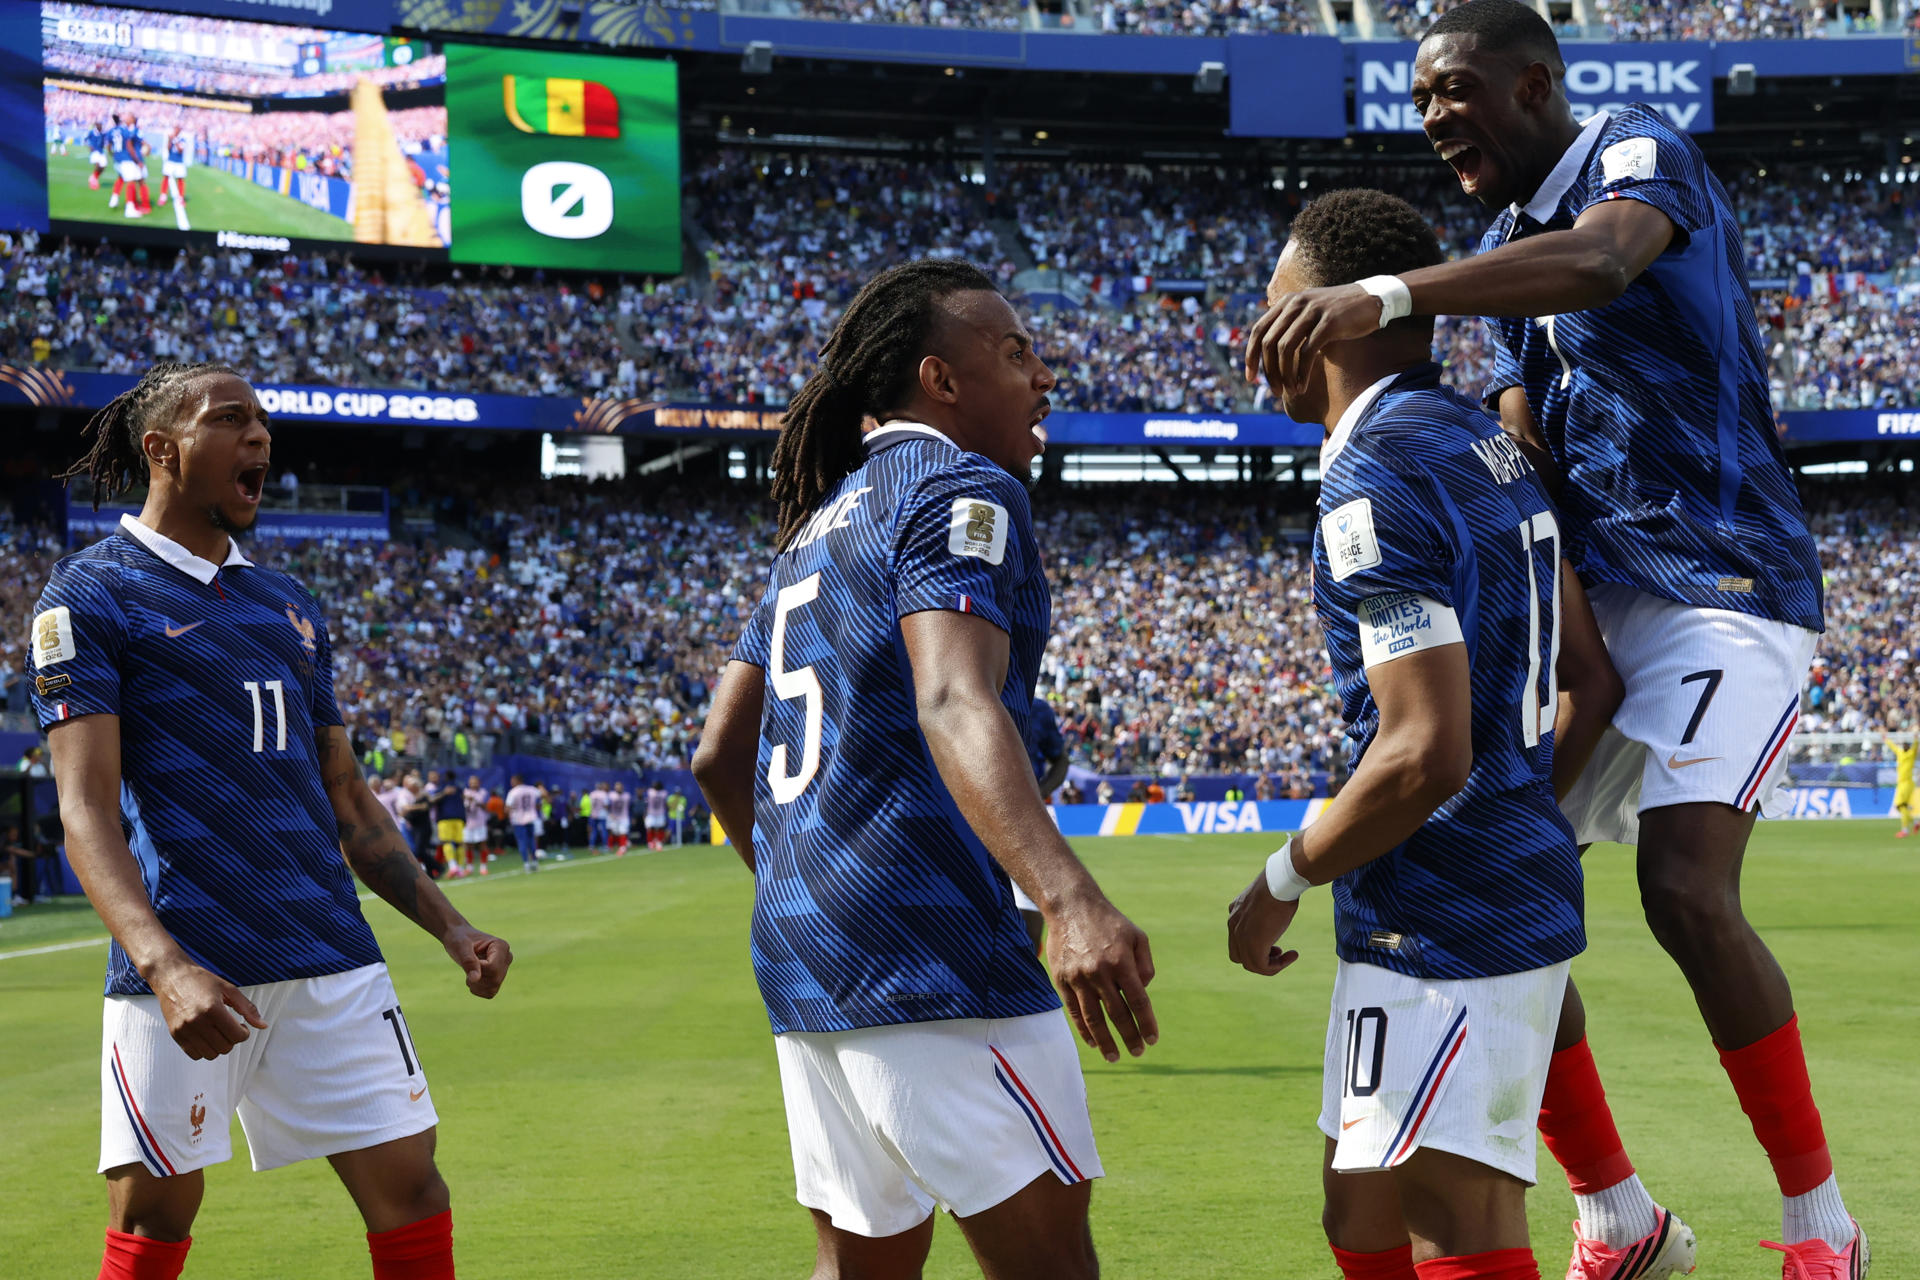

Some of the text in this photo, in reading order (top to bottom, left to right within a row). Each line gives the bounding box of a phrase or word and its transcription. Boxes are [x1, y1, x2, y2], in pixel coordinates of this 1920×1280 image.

[1567, 61, 1699, 94] ORK
[521, 161, 614, 239] 0
[1534, 315, 1571, 390] 7
[334, 393, 387, 417] CUP
[389, 395, 479, 422] 2026
[704, 409, 760, 430] YORK
[963, 546, 990, 556] 2026
[1340, 543, 1363, 561] PEACE
[1369, 598, 1423, 629] UNITES
[1372, 613, 1432, 646] the World
[1390, 638, 1413, 653] FIFA
[45, 677, 66, 686] DEBUT
[767, 571, 823, 805] 5
[243, 680, 288, 752] 11
[1680, 669, 1725, 746] 7
[1173, 801, 1263, 833] VISA
[1343, 1006, 1389, 1098] 10
